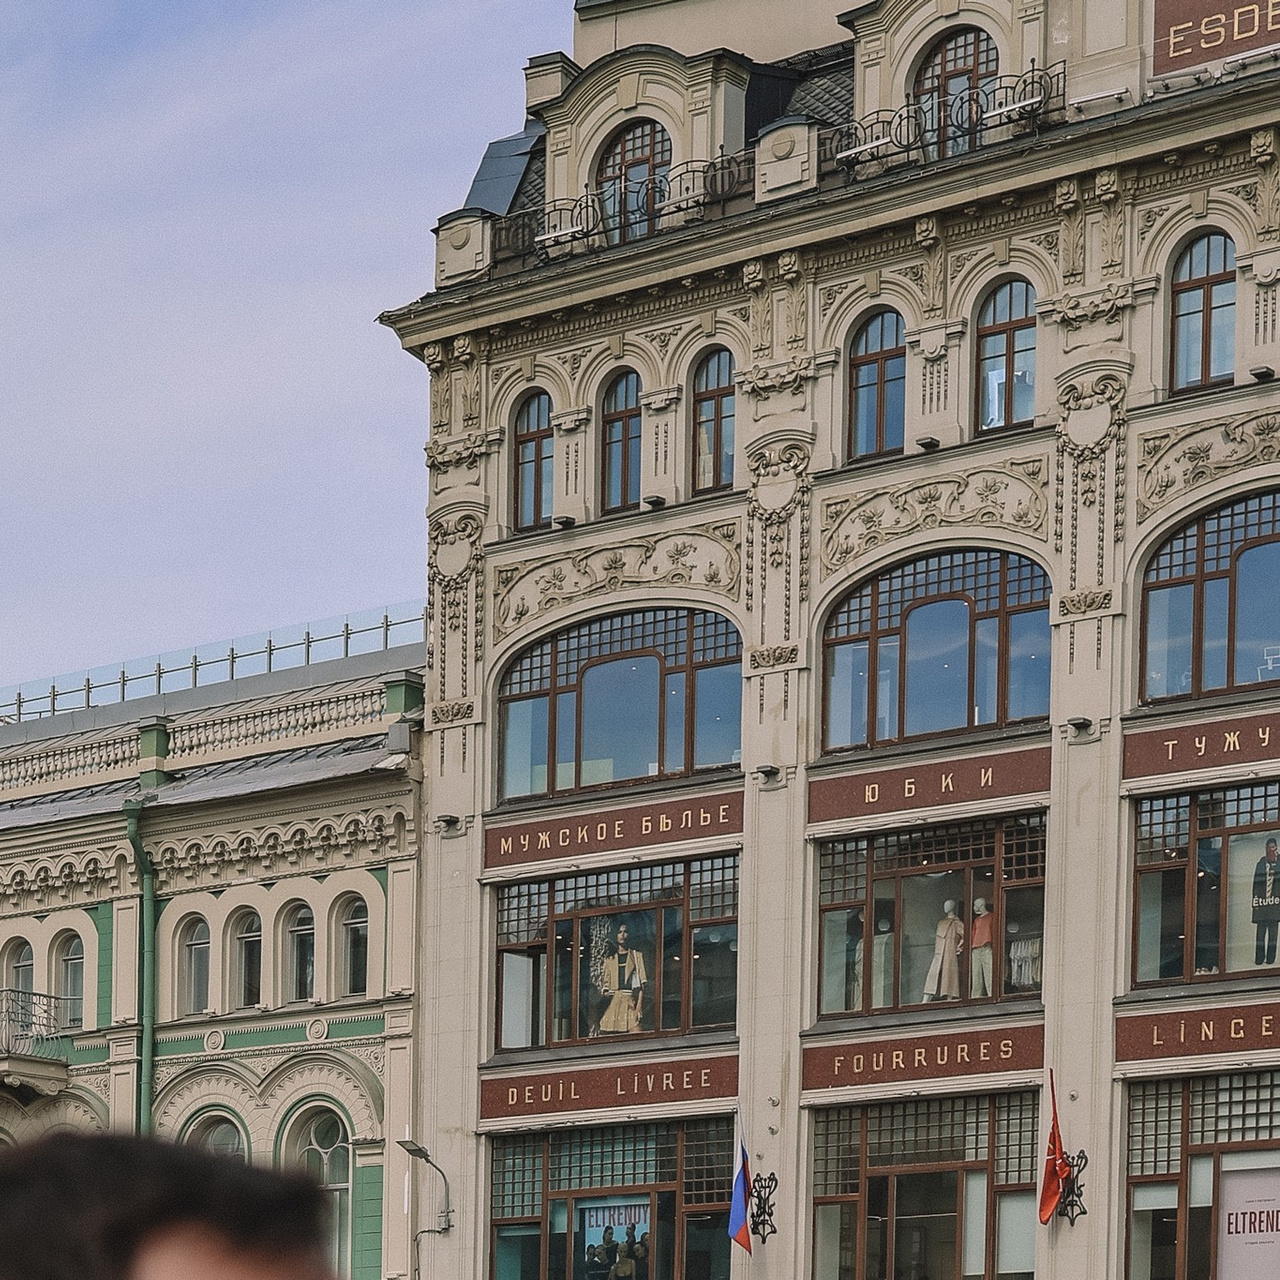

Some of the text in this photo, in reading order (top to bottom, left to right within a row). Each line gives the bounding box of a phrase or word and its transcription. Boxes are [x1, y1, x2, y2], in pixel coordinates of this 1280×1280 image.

[1163, 726, 1270, 760] ТУЖУ
[864, 767, 993, 804] ЮБКИ
[500, 820, 624, 855] МУЖСКОЕ
[834, 1039, 1013, 1075] FOURRURES
[507, 1068, 712, 1105] DEUIL LIVREE
